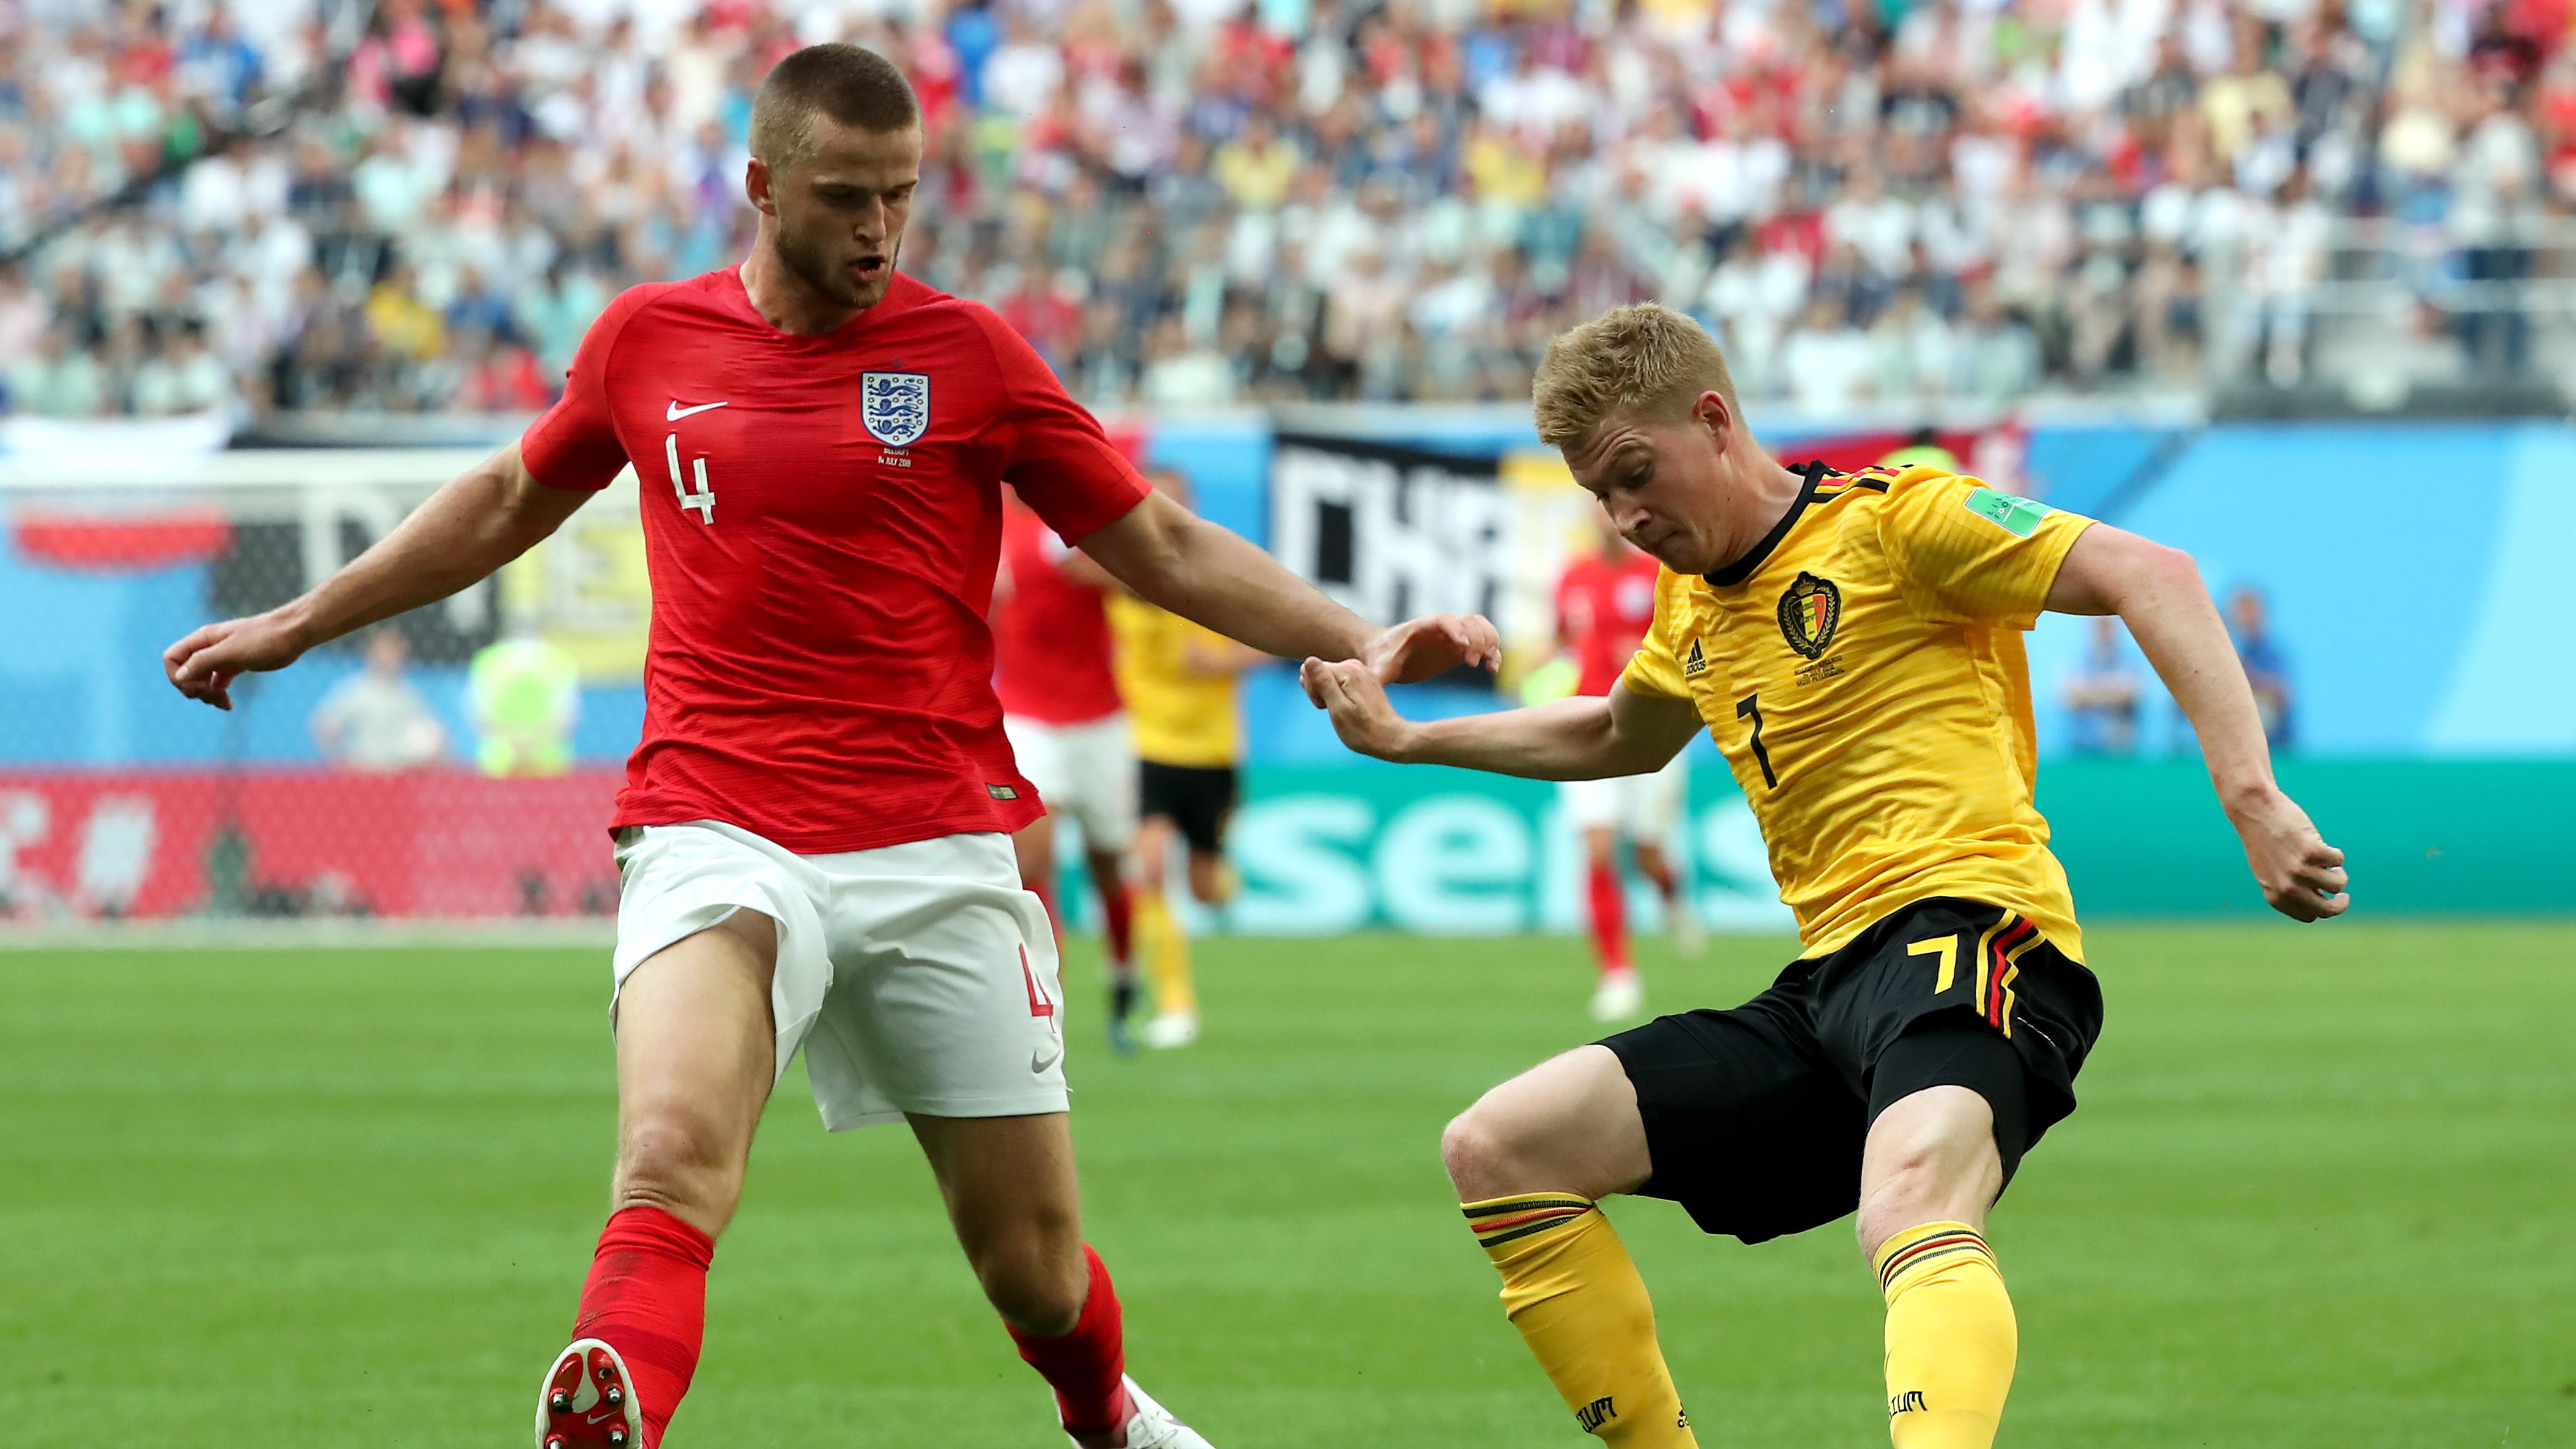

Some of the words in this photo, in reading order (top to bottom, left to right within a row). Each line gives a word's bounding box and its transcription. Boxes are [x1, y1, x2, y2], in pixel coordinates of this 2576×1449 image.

[666, 433, 717, 525] 4
[1686, 659, 1706, 675] adidas
[1737, 694, 1778, 790] 7
[1018, 942, 1057, 1035] 4
[1907, 933, 1958, 995] 7
[1576, 1396, 1618, 1433] IUM
[1888, 1390, 1928, 1420] IUM
